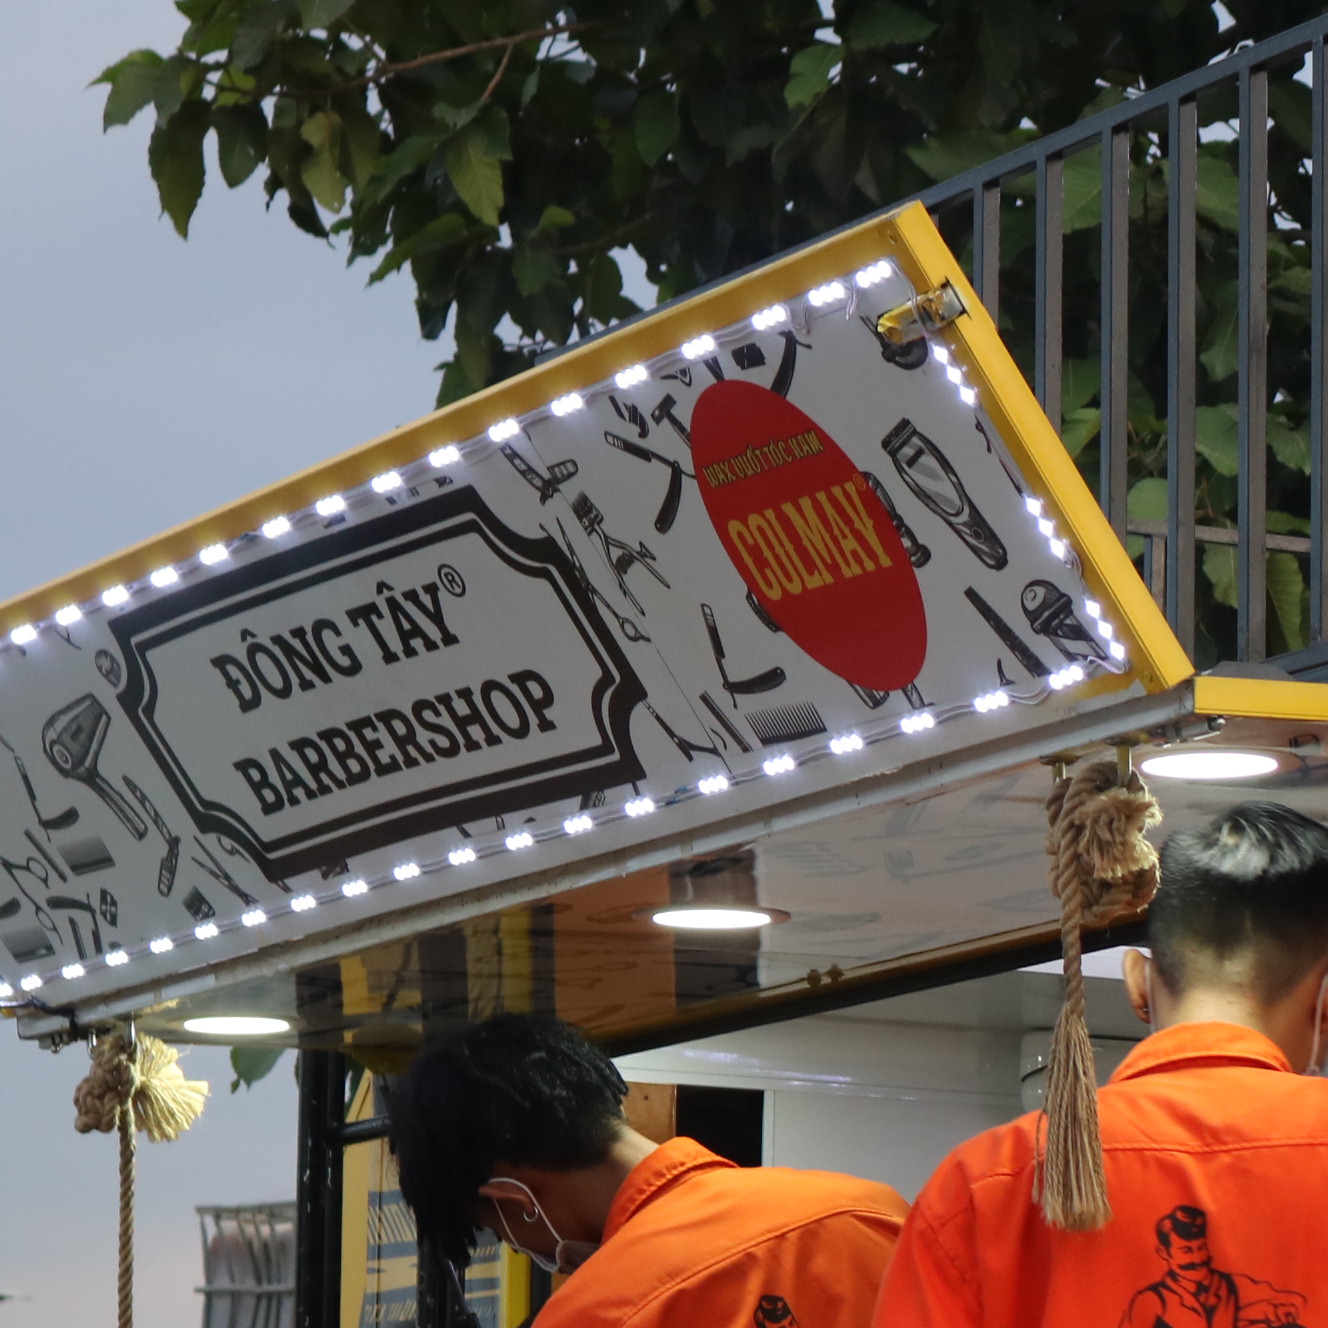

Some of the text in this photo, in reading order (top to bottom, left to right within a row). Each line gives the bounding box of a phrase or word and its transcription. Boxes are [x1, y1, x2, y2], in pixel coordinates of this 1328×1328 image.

[702, 461, 737, 488] WAX
[727, 480, 893, 601] COLMAY
[209, 628, 363, 714] ĐÔNG
[231, 669, 558, 817] BARBERSHOP
